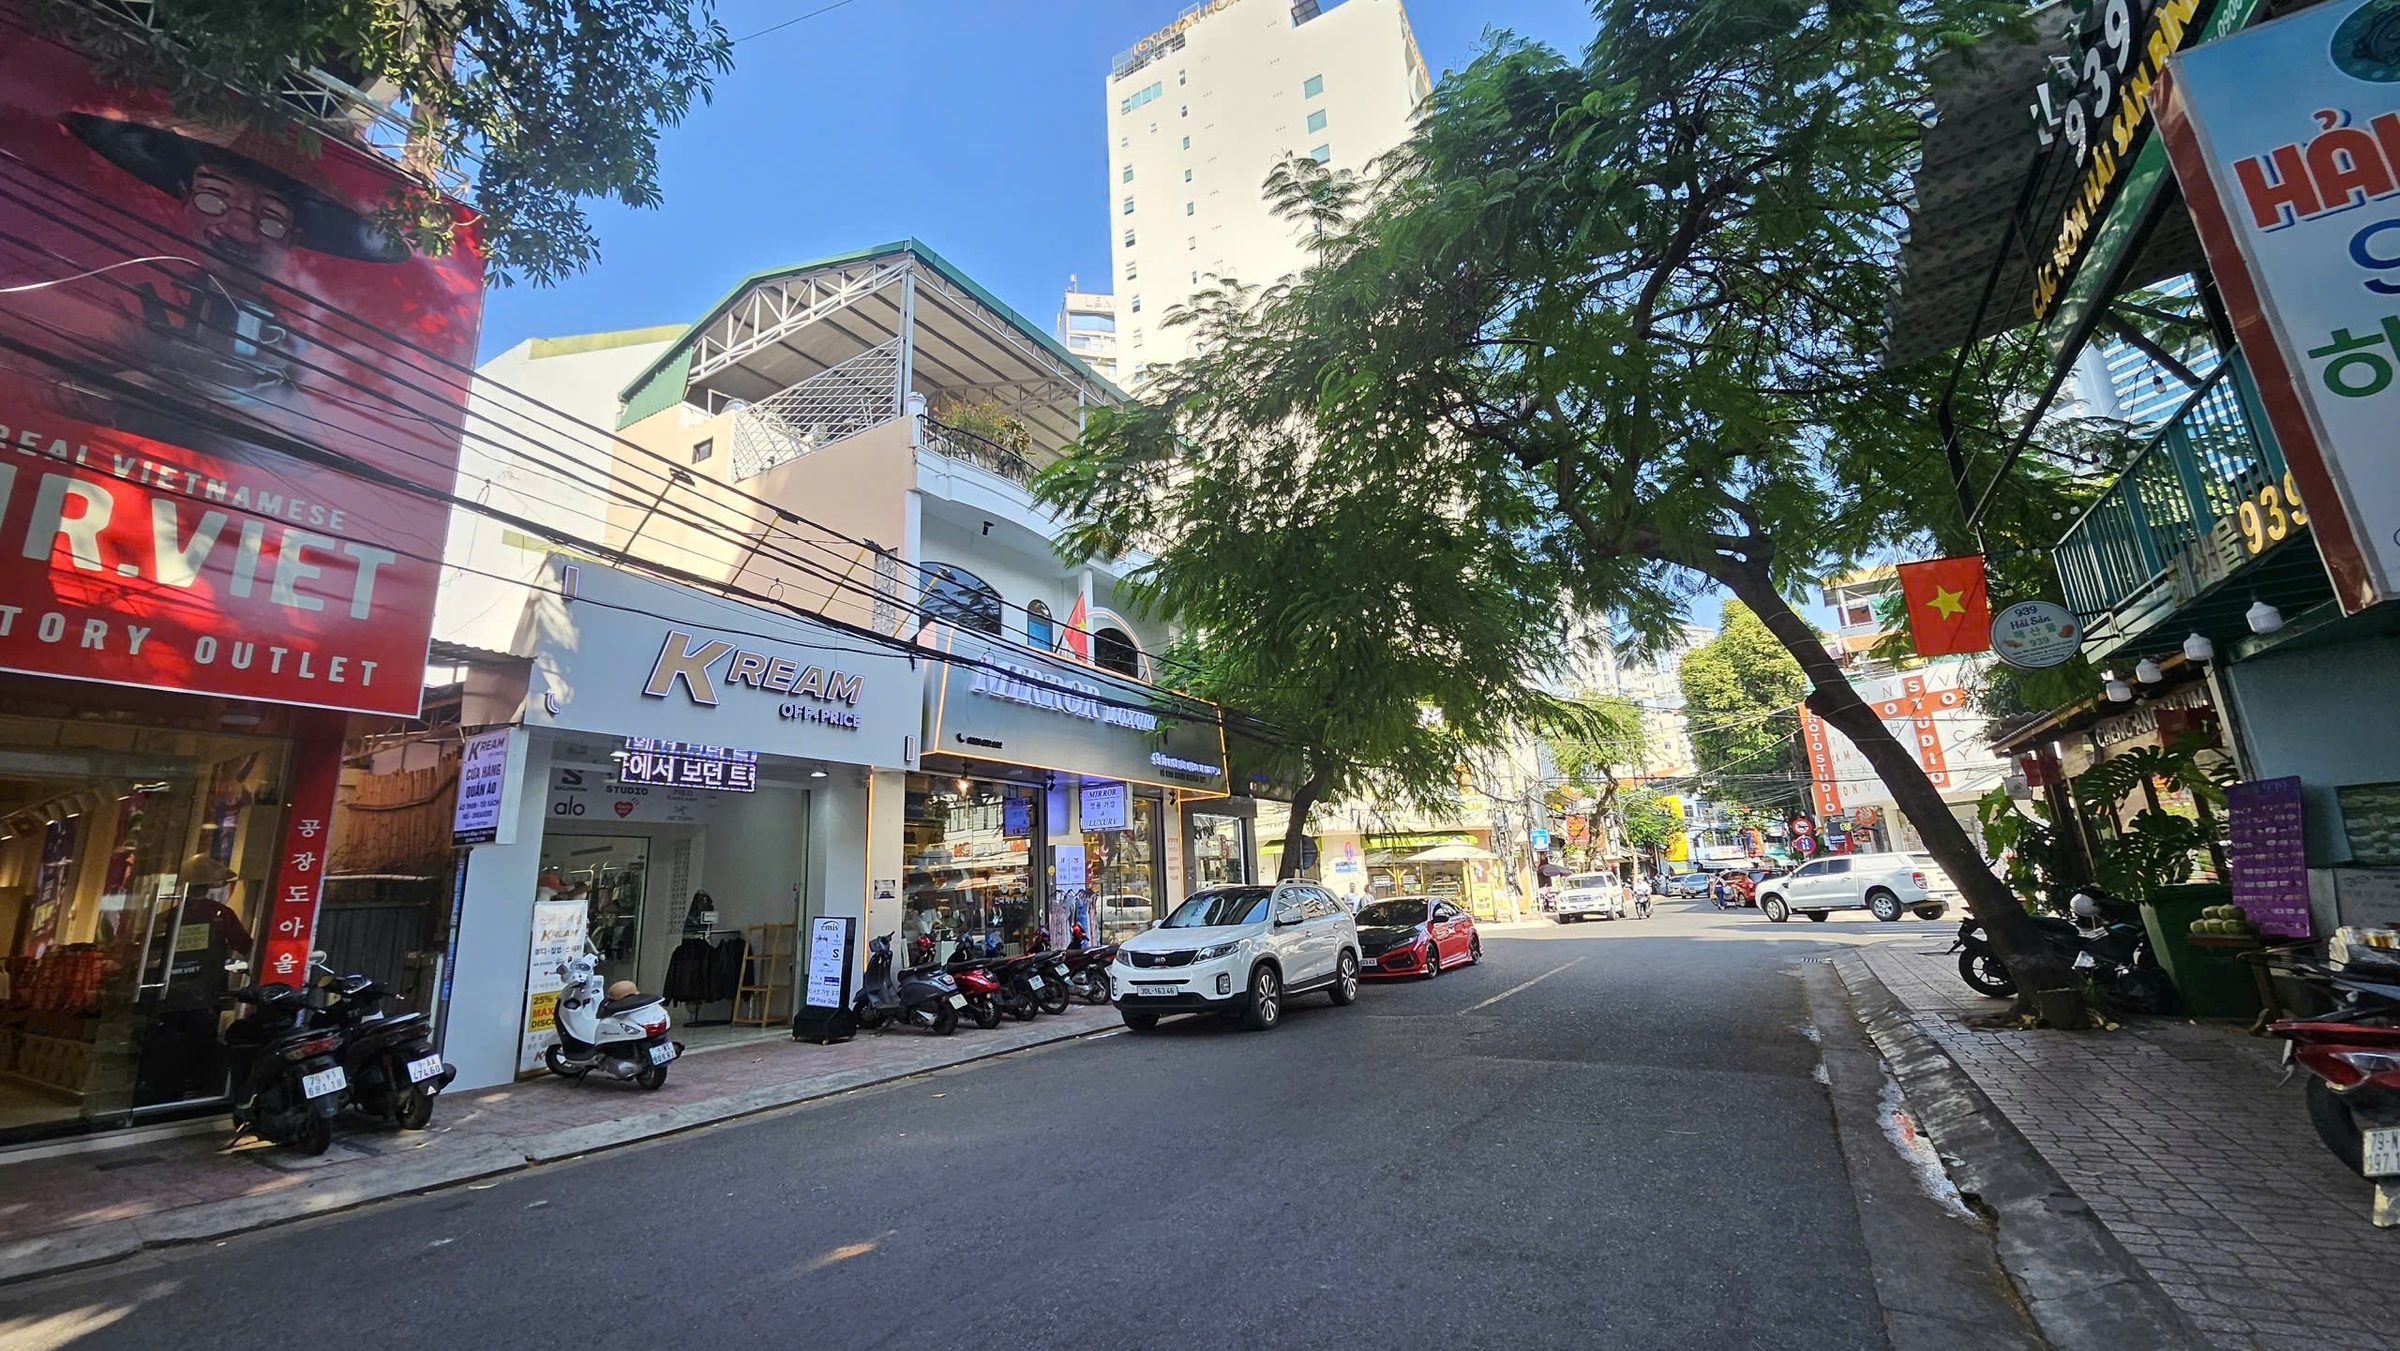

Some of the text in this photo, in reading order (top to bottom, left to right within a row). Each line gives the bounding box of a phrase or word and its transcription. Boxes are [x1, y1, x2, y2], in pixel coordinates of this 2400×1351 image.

[112, 453, 346, 531] VIETNAMESE
[2015, 605, 2037, 617] 939
[2029, 636, 2050, 647] 939
[195, 636, 379, 686] OUTLET
[642, 630, 864, 705] KREAM
[780, 702, 863, 729] OFF-PRICE
[467, 738, 505, 761] KREAM
[680, 761, 722, 785] 보던
[1815, 754, 1835, 812] STUDIO
[606, 784, 649, 795] STUDIO
[1089, 788, 1117, 798] MIRROR
[554, 795, 585, 816] alo
[1089, 817, 1118, 827] LUXURY
[821, 922, 839, 931] emis
